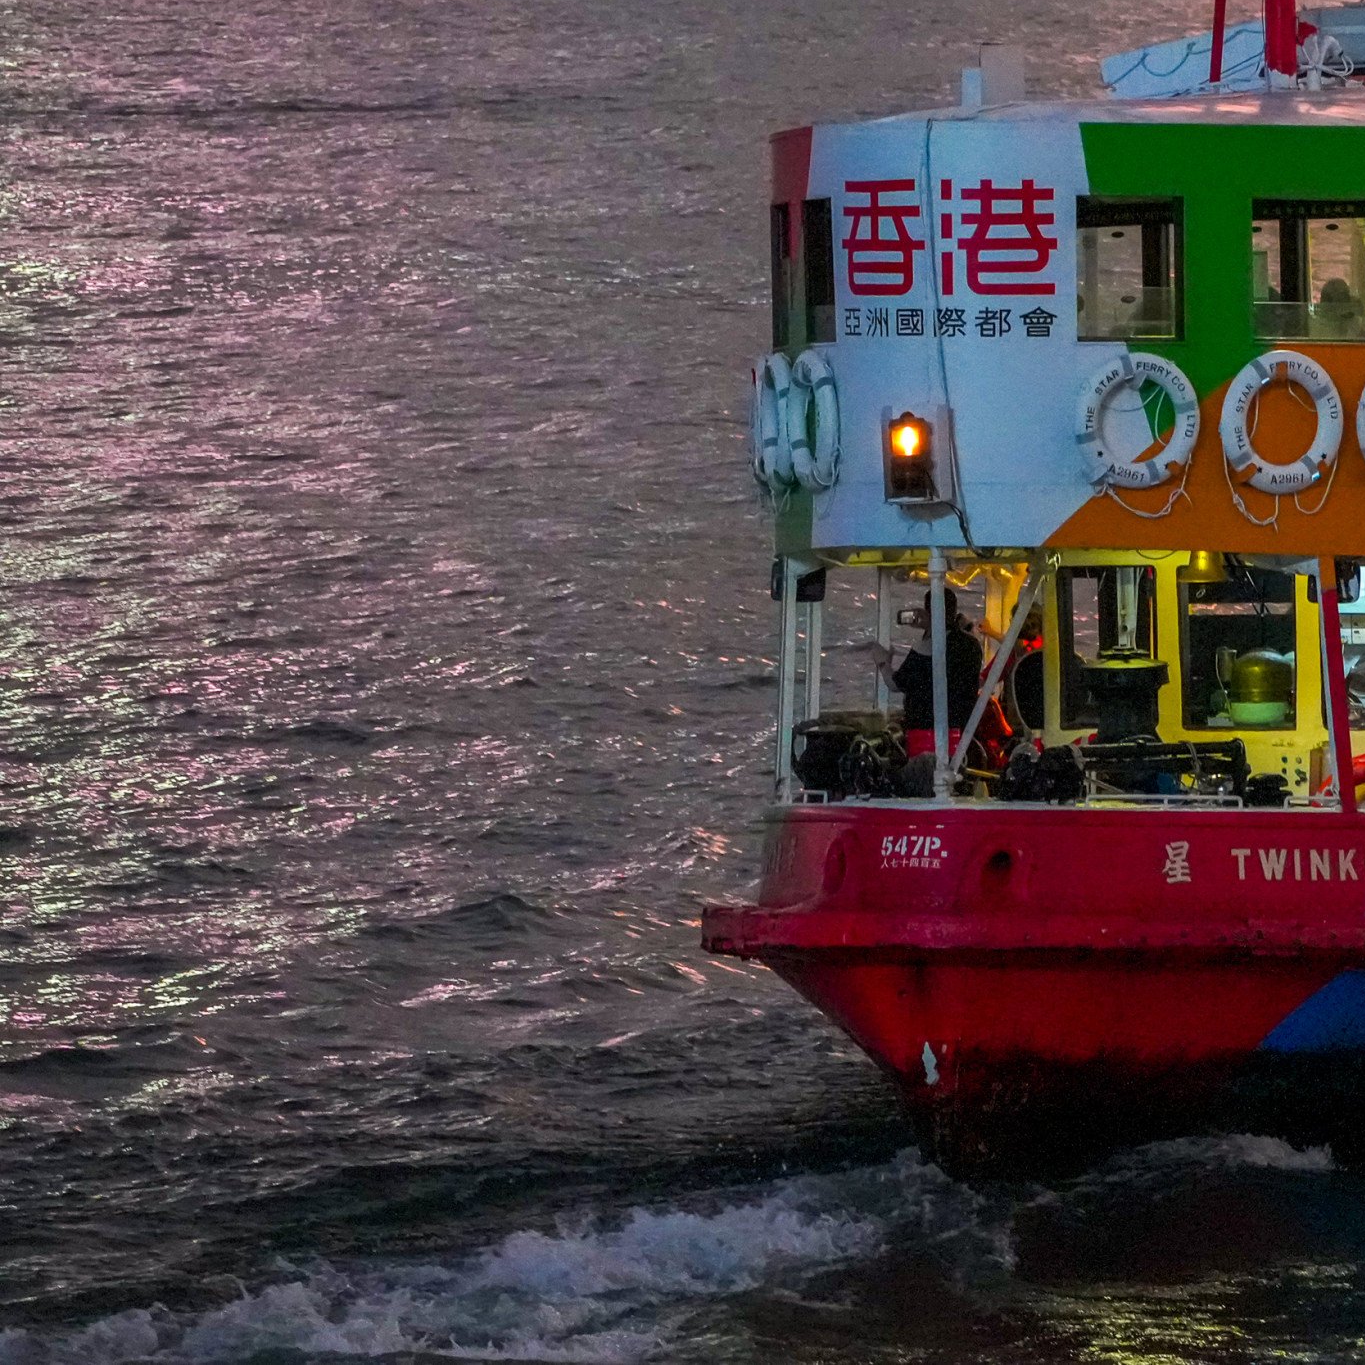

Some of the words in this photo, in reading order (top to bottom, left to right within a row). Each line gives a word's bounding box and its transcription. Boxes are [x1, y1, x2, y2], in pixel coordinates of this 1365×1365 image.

[841, 178, 1058, 296] 香港
[844, 306, 1058, 338] 亞洲國際都會
[1085, 407, 1095, 431] THE
[1095, 369, 1119, 396] STAR
[1136, 362, 1172, 378] FERRY
[1234, 427, 1245, 450] THE
[1162, 840, 1192, 884] 星
